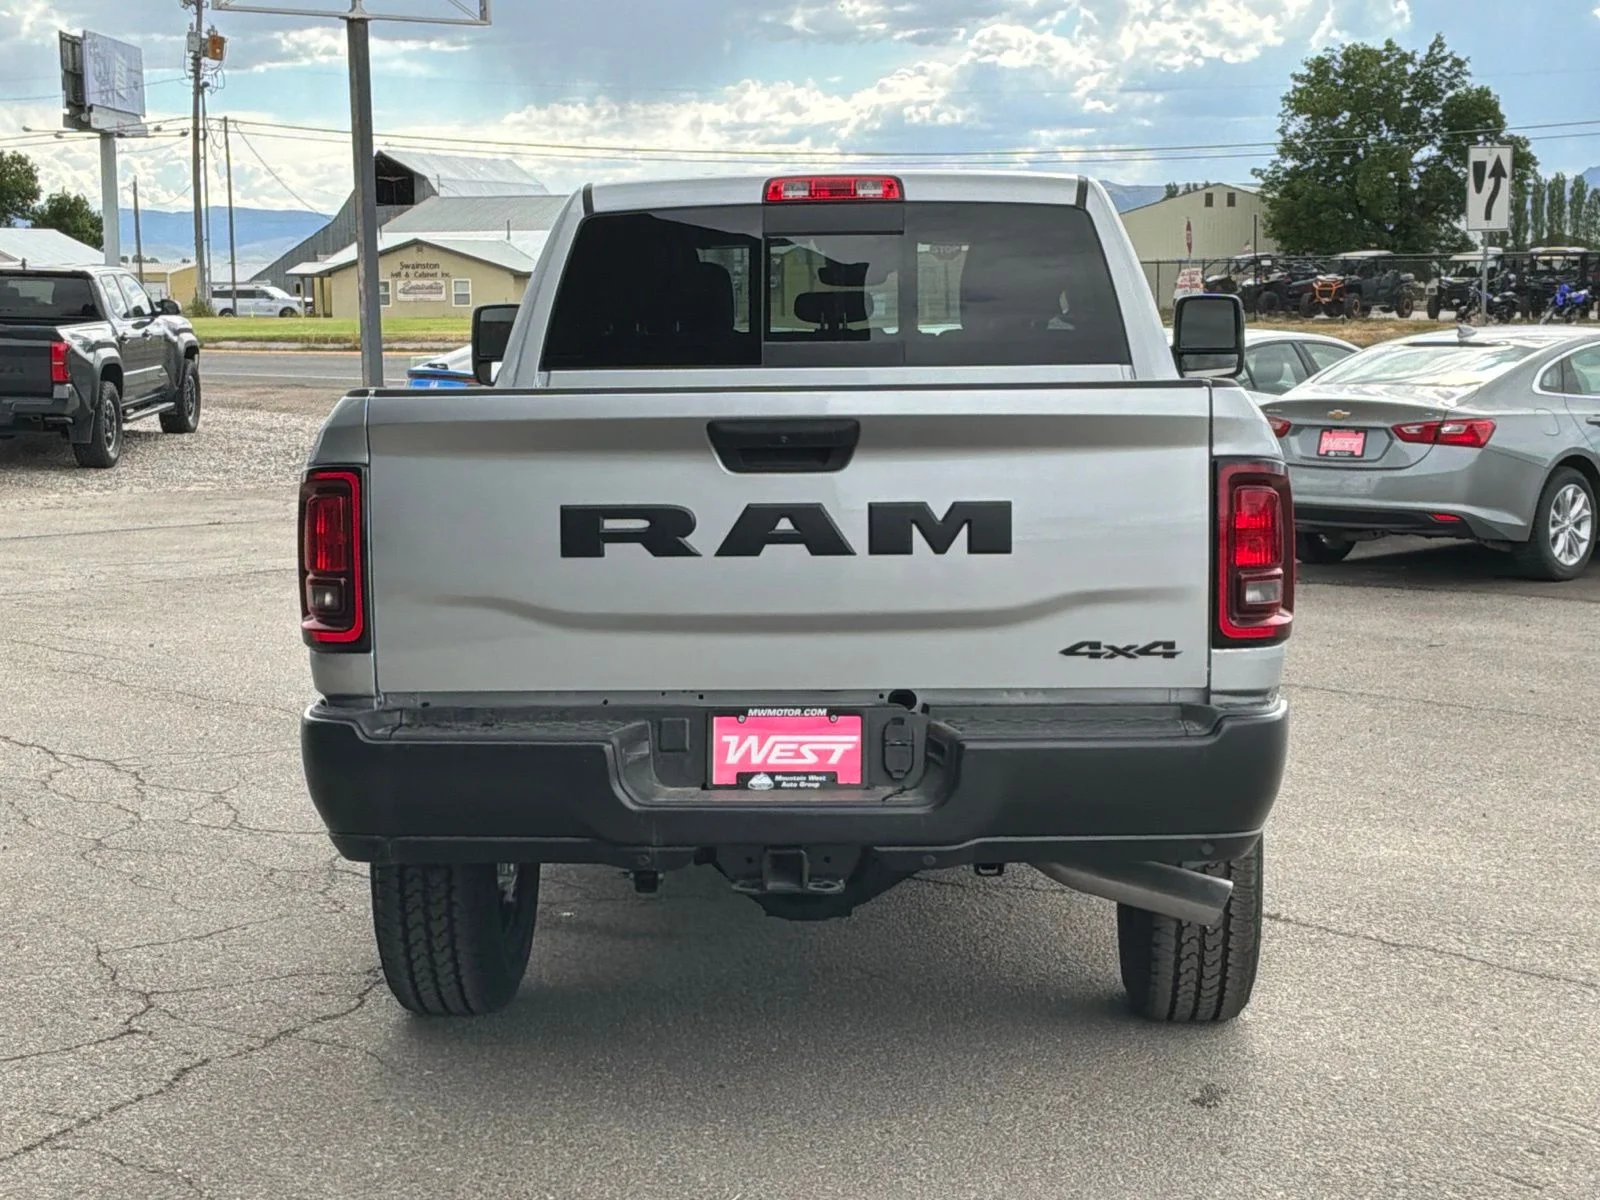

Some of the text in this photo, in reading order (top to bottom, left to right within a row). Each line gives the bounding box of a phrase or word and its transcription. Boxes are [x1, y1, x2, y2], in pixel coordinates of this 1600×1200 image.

[400, 261, 440, 270] Swainston
[560, 501, 1012, 558] RAM
[1058, 640, 1183, 660] 4x4
[747, 708, 827, 717] MWMOTOR.COM
[721, 735, 859, 765] WEST
[799, 781, 820, 789] Group
